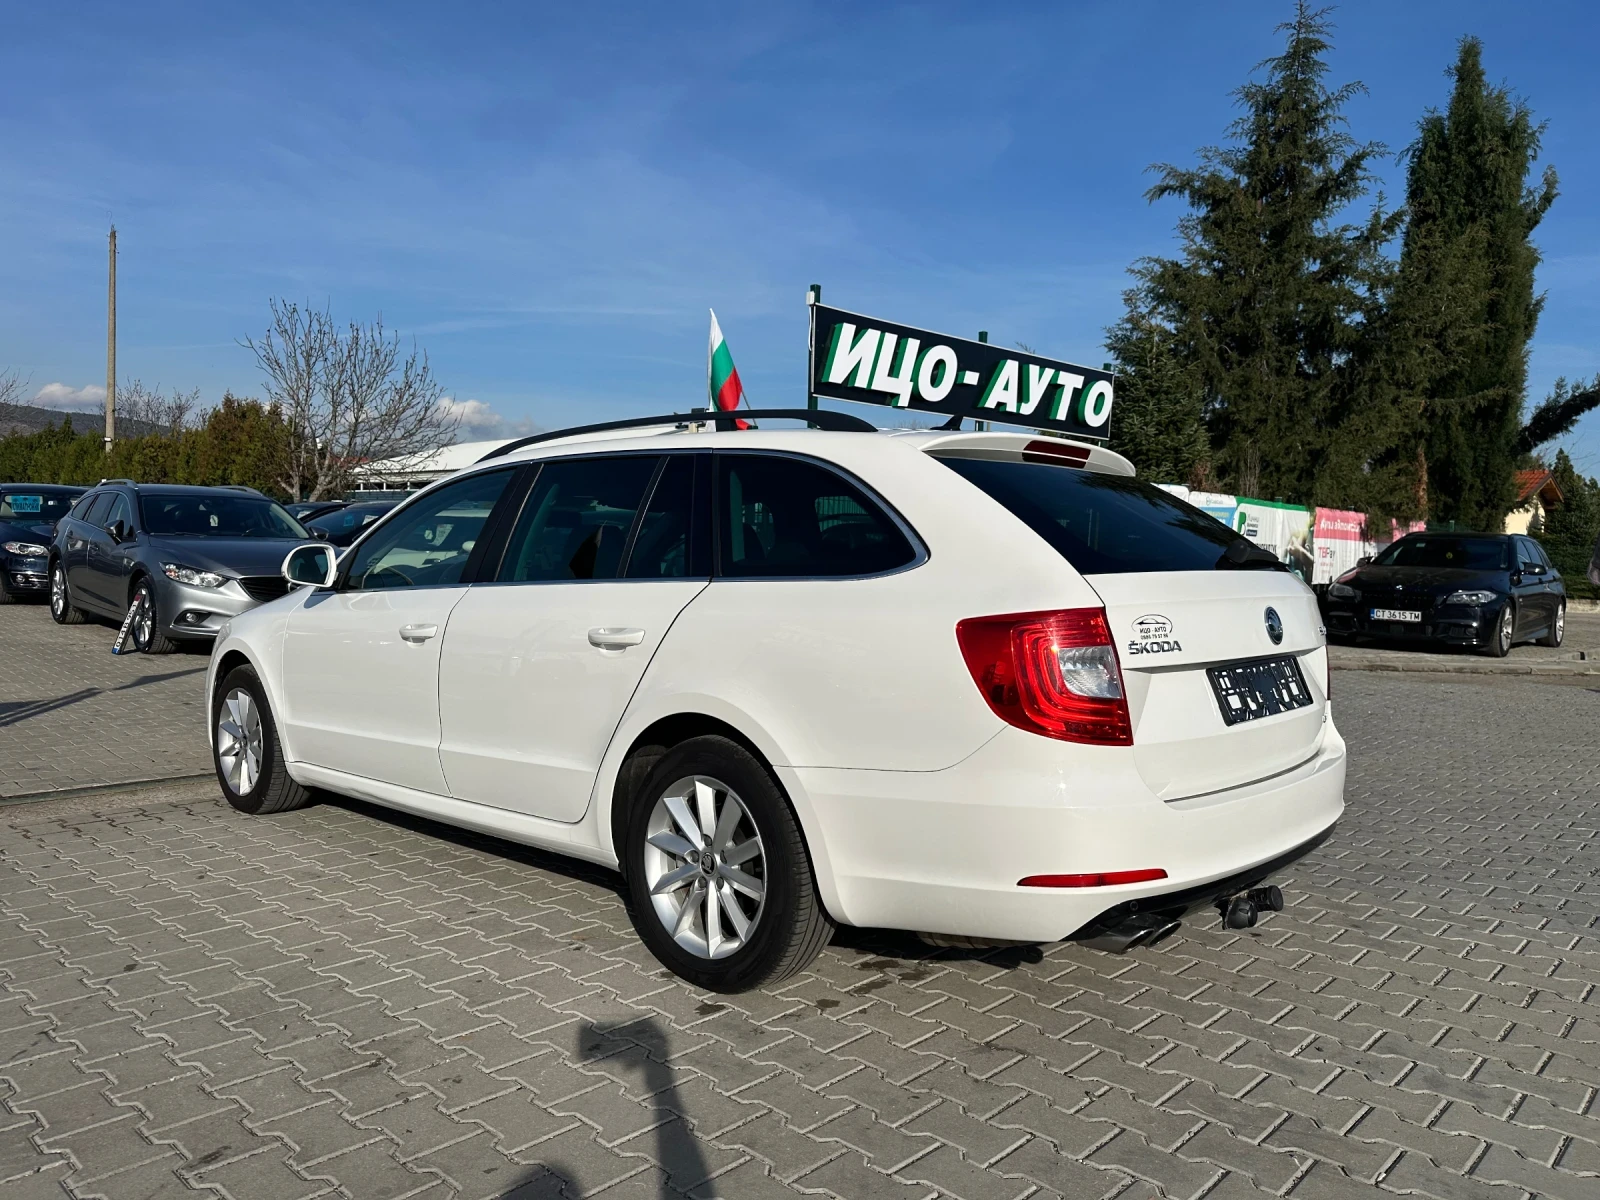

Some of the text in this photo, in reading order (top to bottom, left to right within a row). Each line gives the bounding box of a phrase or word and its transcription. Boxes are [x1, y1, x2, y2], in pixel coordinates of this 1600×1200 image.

[1376, 610, 1420, 620] CT 3615 TM
[1128, 640, 1182, 655] ŠKODA
